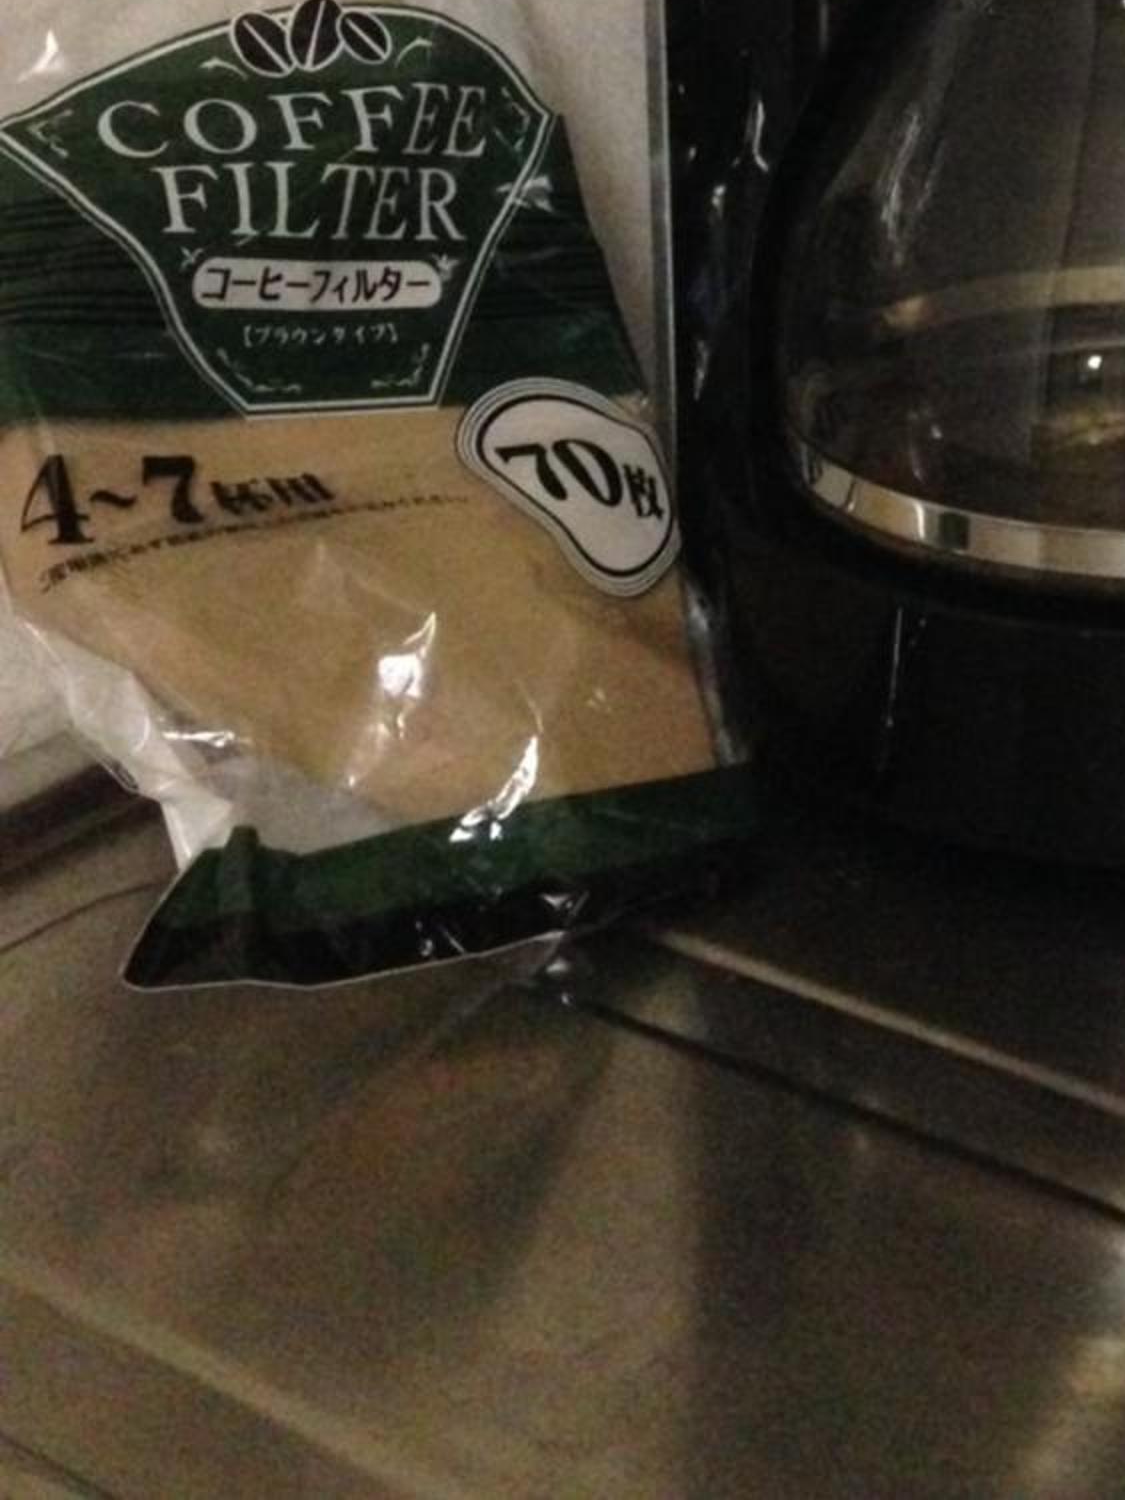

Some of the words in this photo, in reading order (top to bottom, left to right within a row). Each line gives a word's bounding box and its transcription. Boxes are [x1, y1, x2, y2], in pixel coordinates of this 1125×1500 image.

[98, 83, 488, 159] COFFEE
[155, 161, 466, 244] FILTER
[201, 266, 431, 304] コーヒーフィルター
